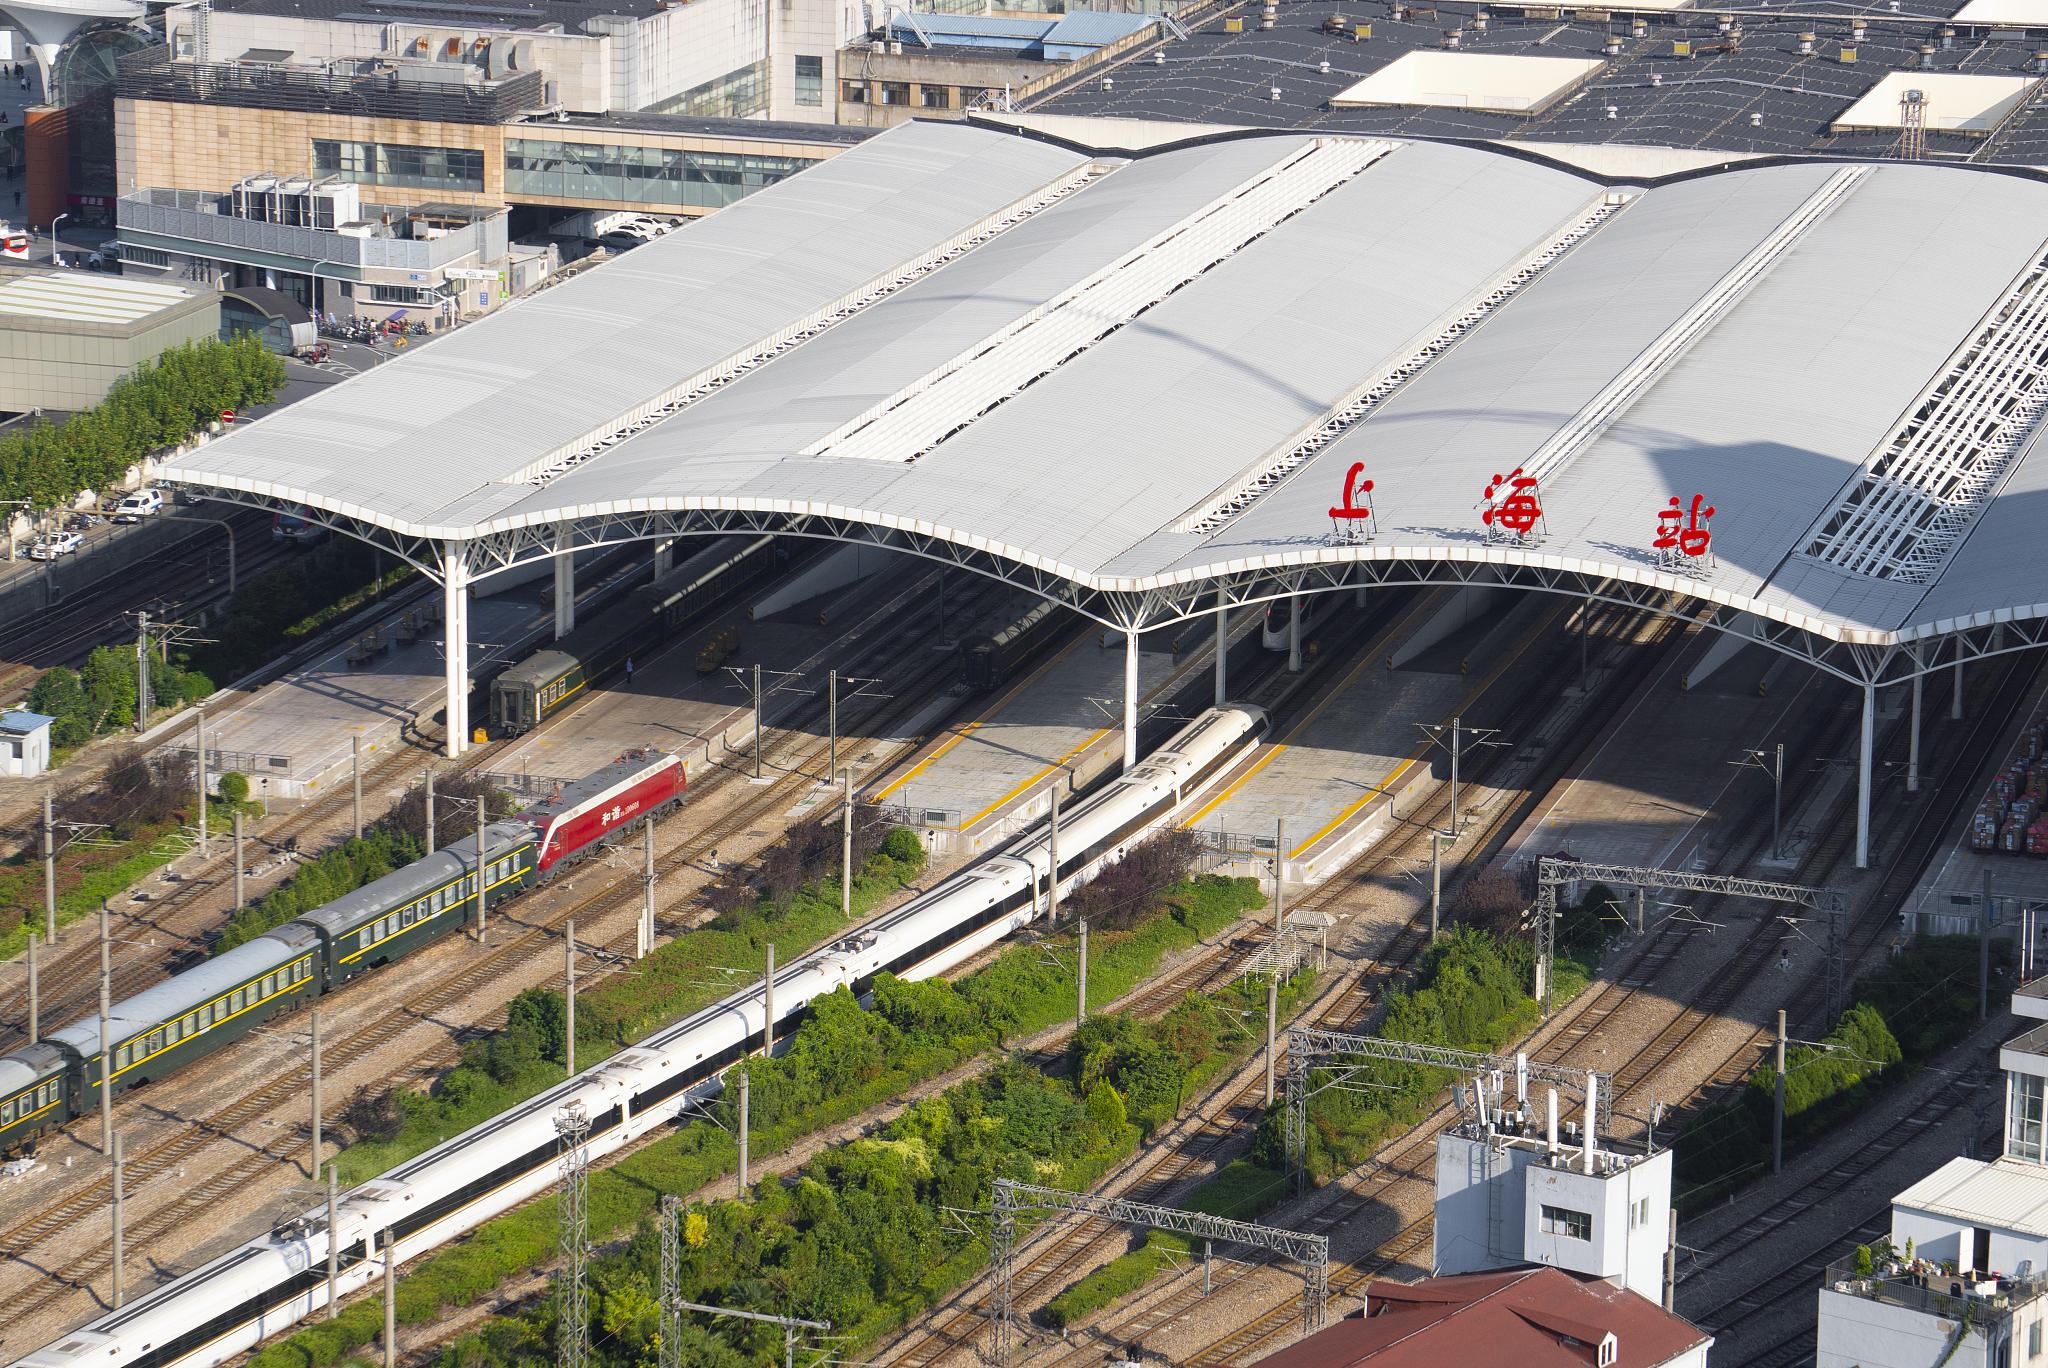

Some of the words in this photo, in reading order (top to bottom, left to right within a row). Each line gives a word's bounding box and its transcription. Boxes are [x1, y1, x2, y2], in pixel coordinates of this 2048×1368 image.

[81, 196, 104, 206] 肯德基
[1328, 462, 1716, 557] 上海站
[601, 805, 621, 826] 和谐
